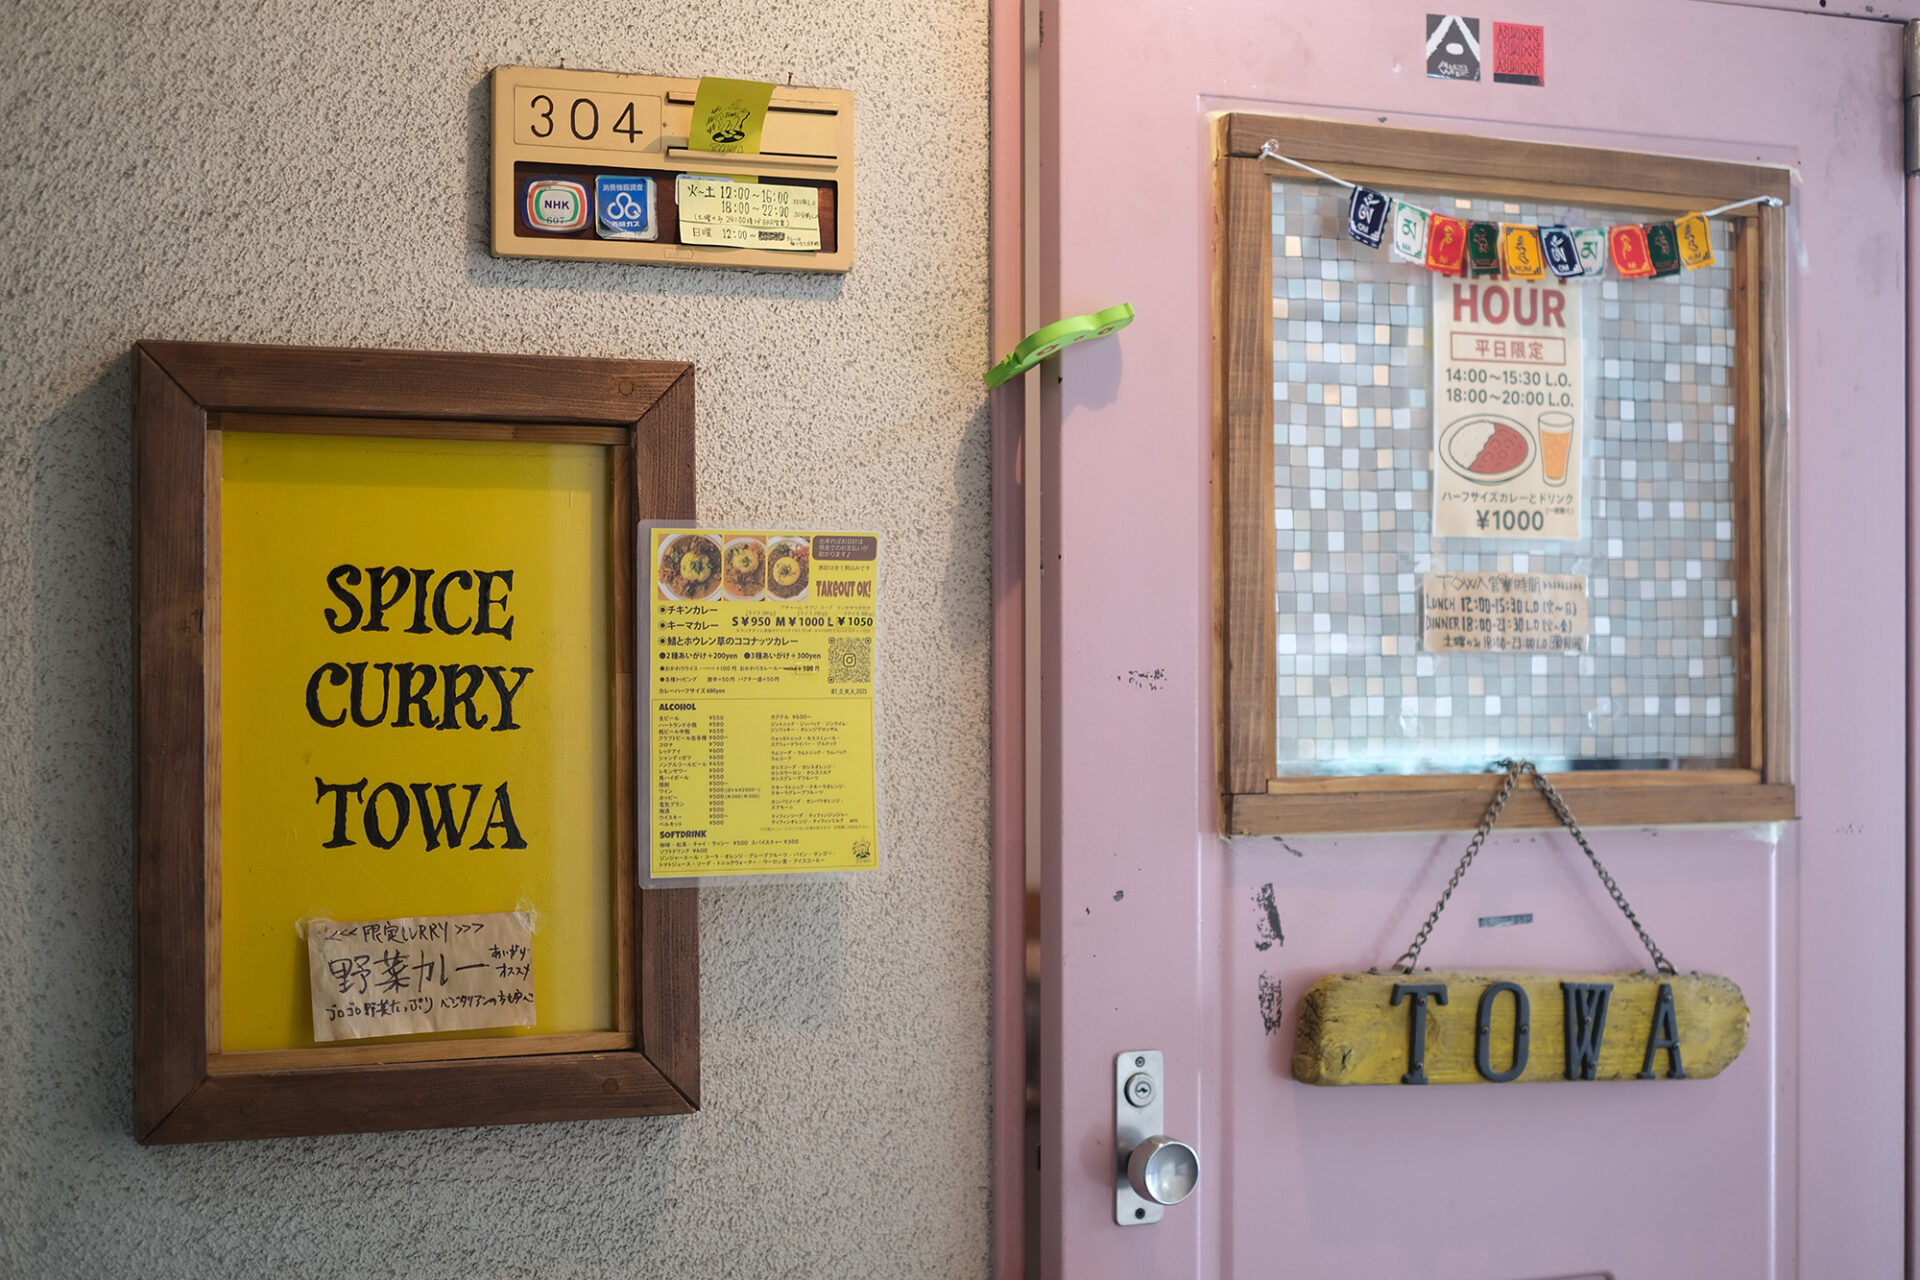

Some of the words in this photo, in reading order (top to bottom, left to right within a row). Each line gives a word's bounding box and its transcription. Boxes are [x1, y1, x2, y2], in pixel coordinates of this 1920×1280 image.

[531, 95, 643, 143] 304
[544, 200, 569, 210] NHK
[546, 216, 565, 224] 607
[1357, 223, 1369, 233] OM
[692, 227, 712, 238] 日曜
[1558, 264, 1569, 272] OM
[1453, 283, 1566, 328] HOUR
[1475, 339, 1543, 360] 平日限定
[1446, 368, 1541, 387] 14:00~15:30
[1545, 373, 1572, 387] L.O.
[1446, 388, 1545, 405] 18:00~20:00
[1548, 392, 1574, 407] L.O.
[1441, 491, 1574, 505] ハーフサイズカレーとドリンク
[1476, 510, 1544, 531] ¥1000
[857, 580, 872, 598] OK!
[324, 564, 514, 641] SPICE
[667, 605, 718, 615] チキンカレー
[1426, 594, 1456, 613] LUNCH
[667, 621, 719, 631] キーマカレー
[732, 616, 738, 627] S
[776, 617, 786, 627] M
[828, 618, 834, 627] L
[1426, 616, 1460, 631] DINNER
[305, 661, 534, 732] CURRY
[659, 703, 696, 711] ALCOHOL
[314, 776, 528, 852] TOWA
[659, 830, 707, 839] SOFTDRINK
[328, 948, 490, 995] 野菜カレー
[495, 963, 530, 981] オススメ
[1390, 981, 1687, 1085] TOWA
